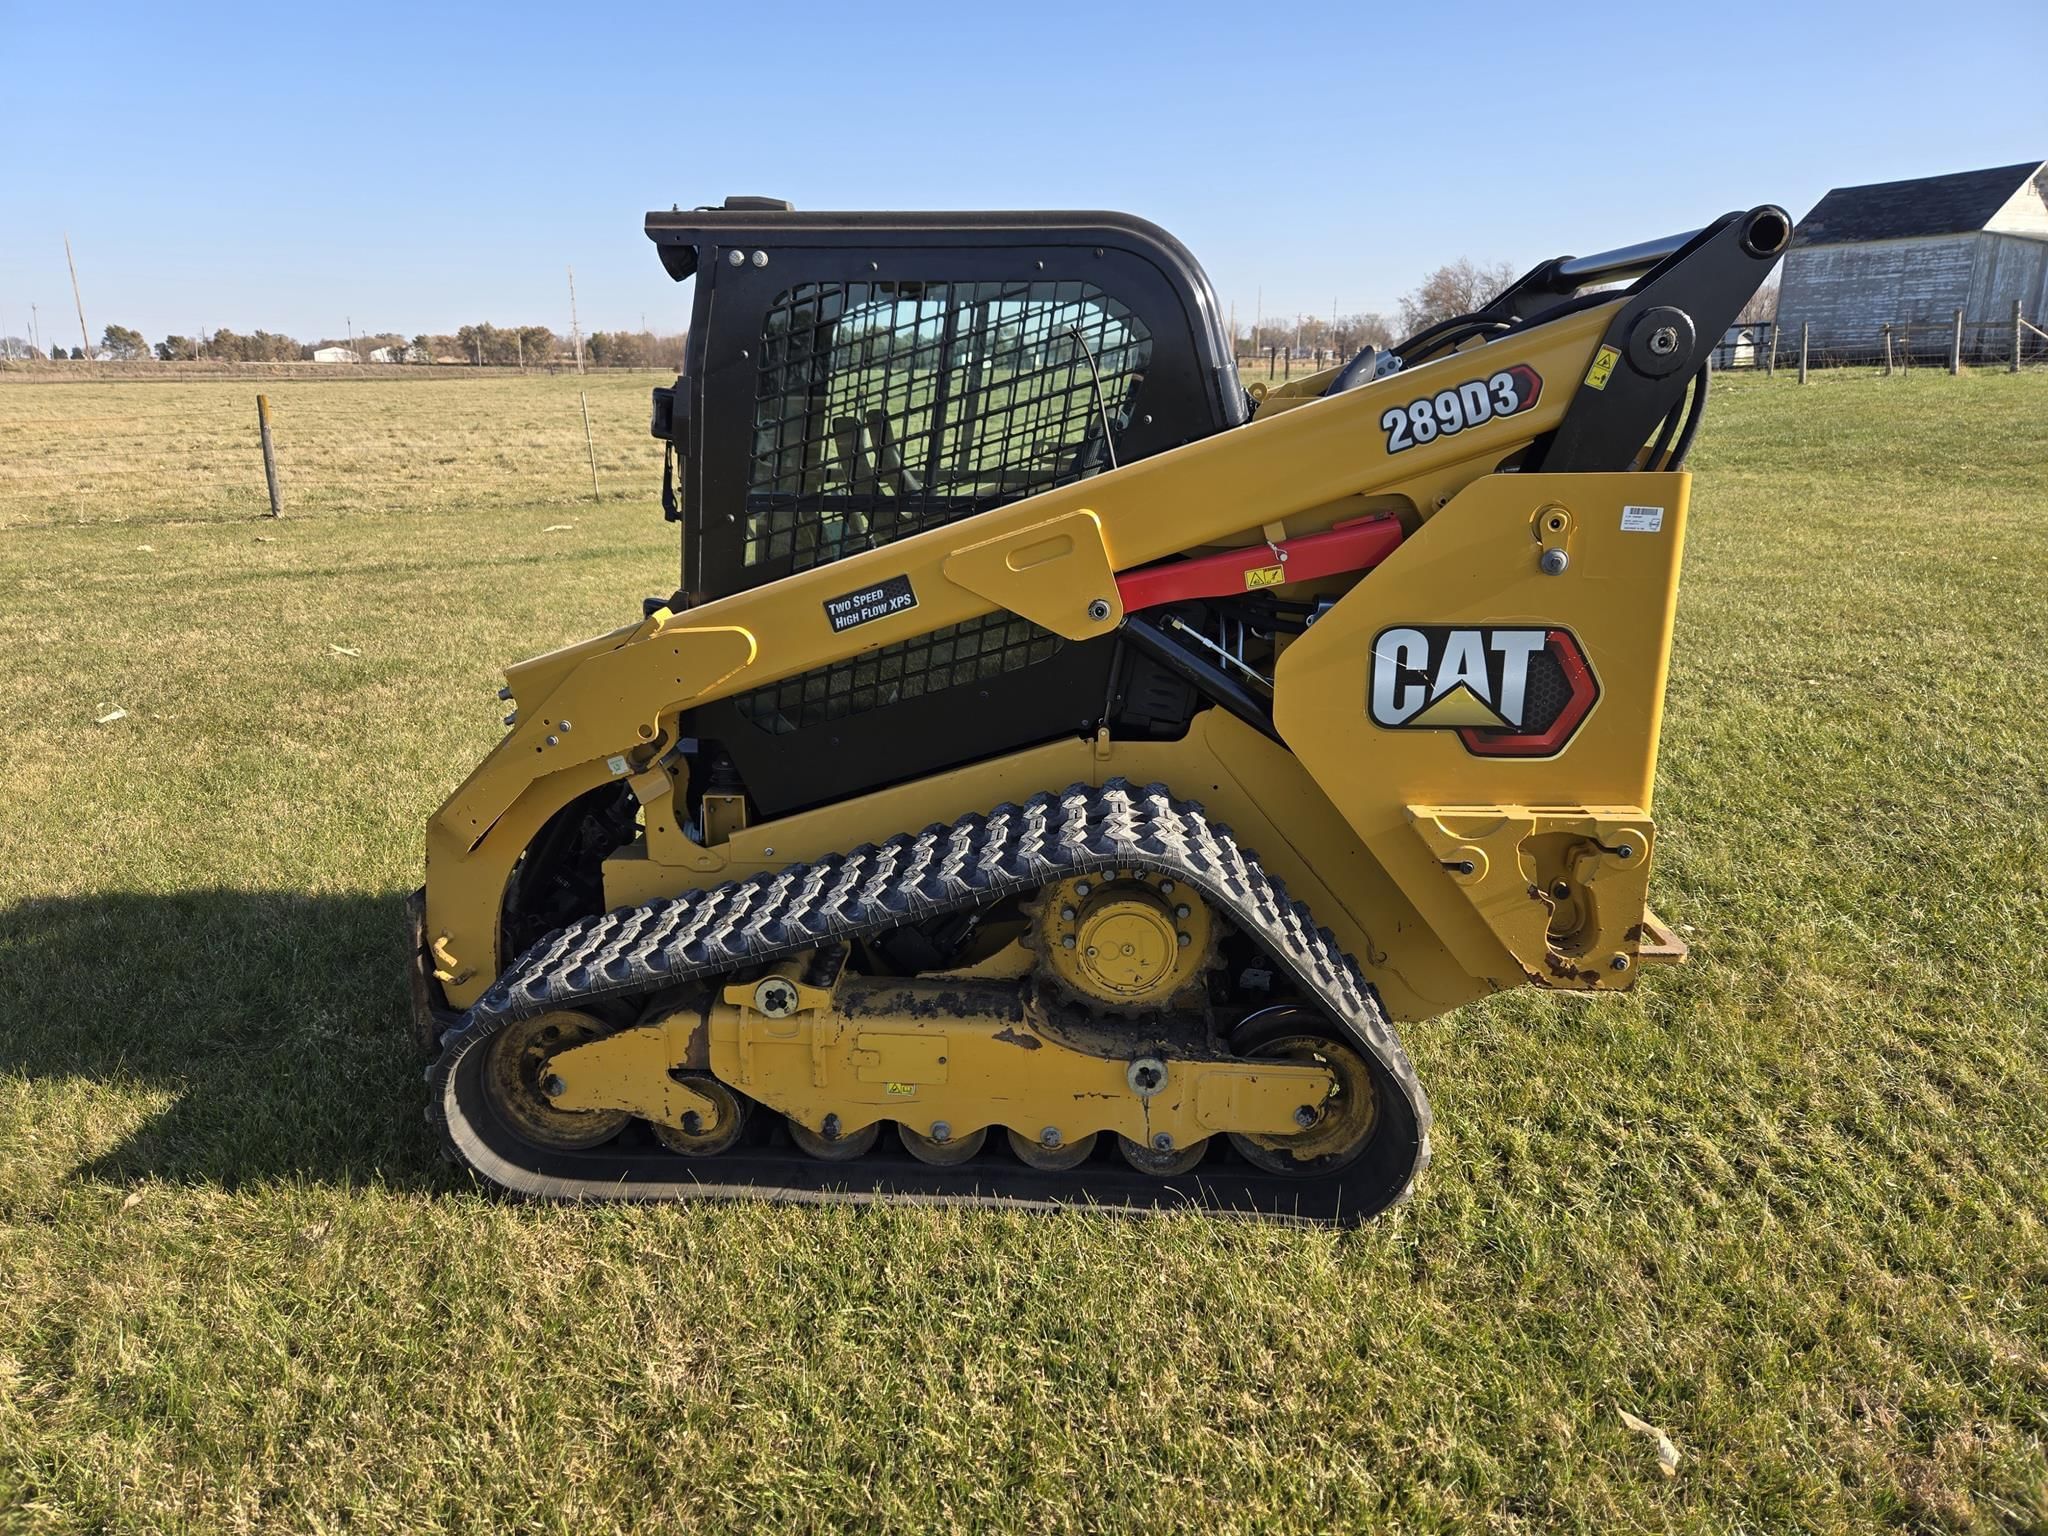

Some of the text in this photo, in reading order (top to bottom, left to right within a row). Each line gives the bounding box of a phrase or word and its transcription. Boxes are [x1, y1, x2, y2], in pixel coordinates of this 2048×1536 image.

[1382, 372, 1519, 452] 289D3
[890, 593, 912, 610] XPS
[1372, 628, 1546, 726] CAT
